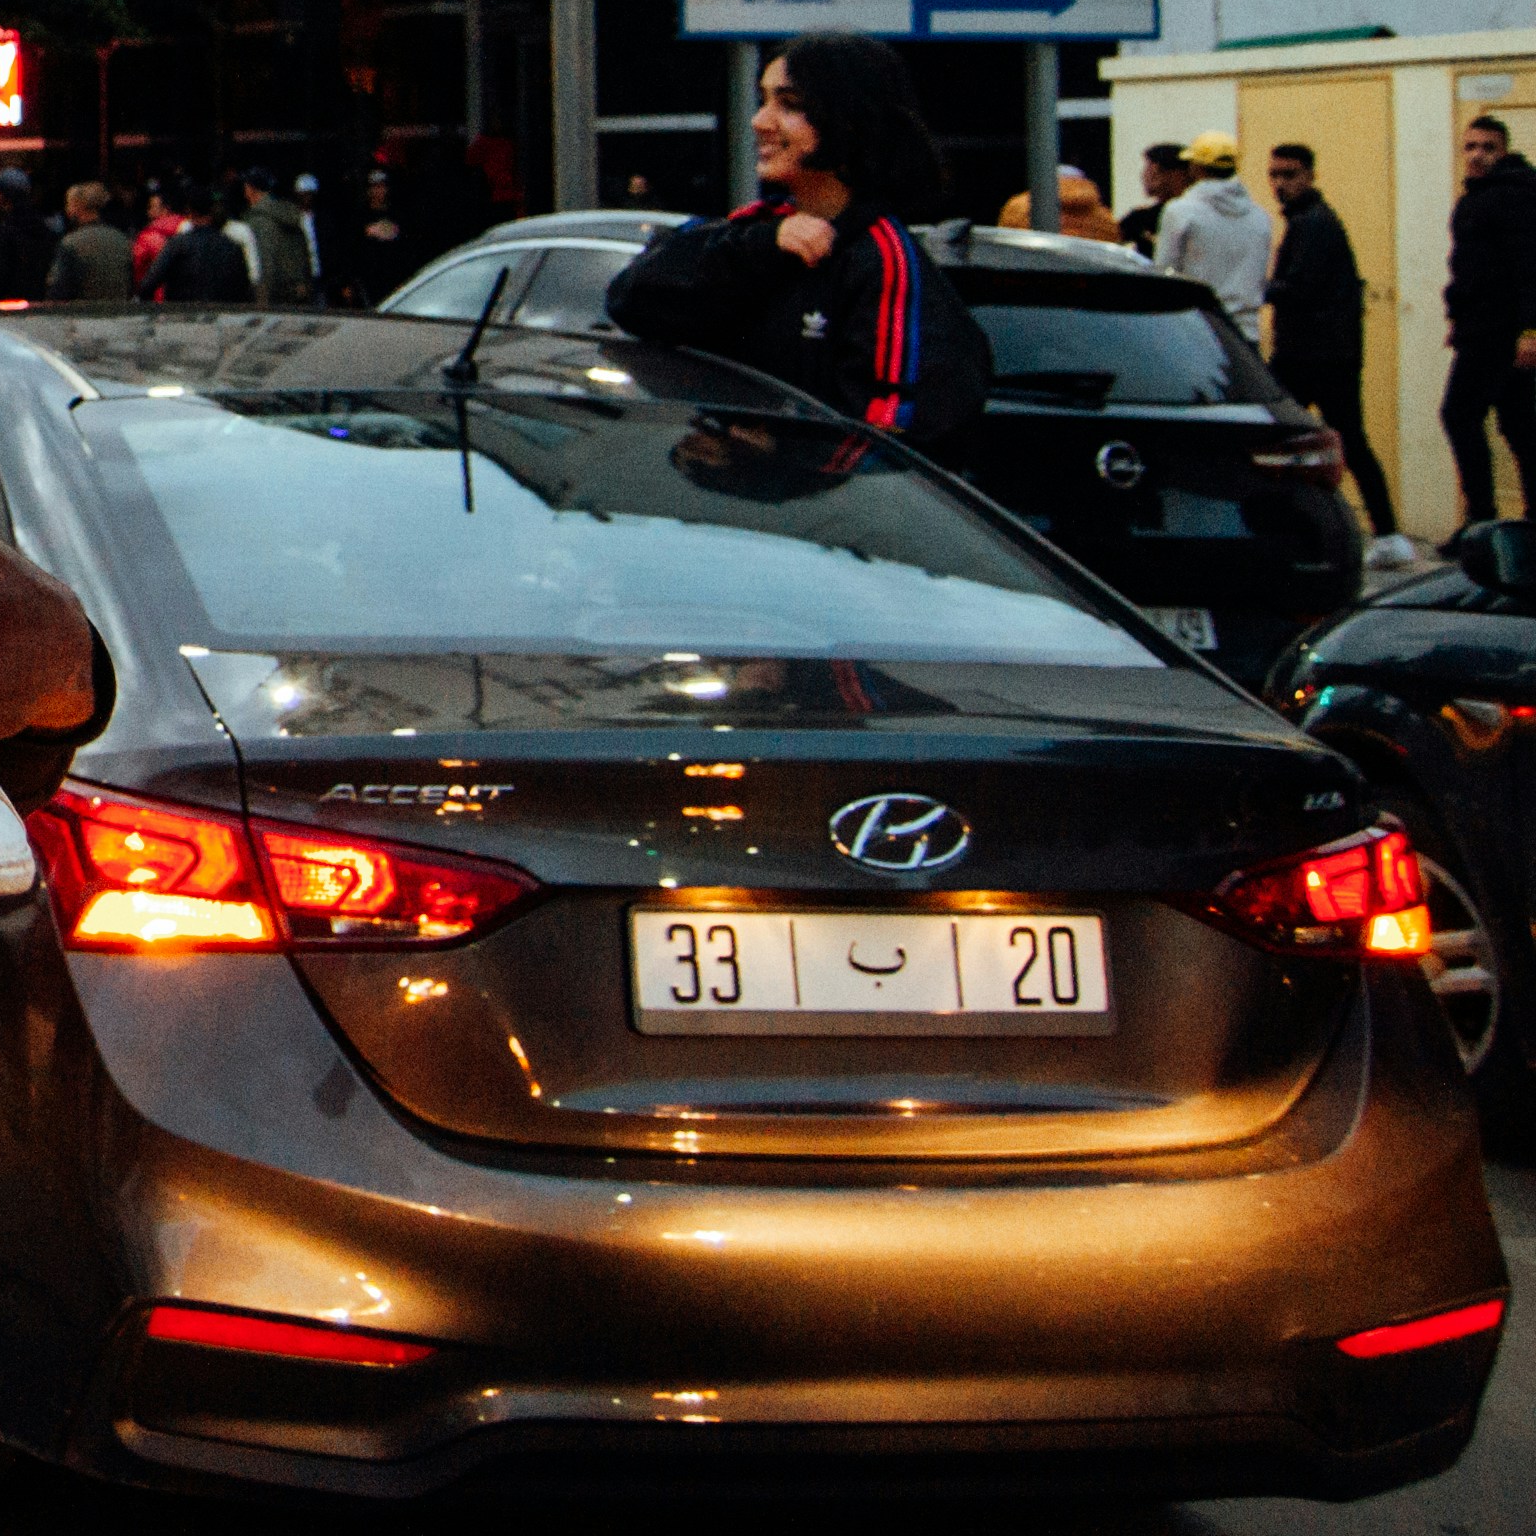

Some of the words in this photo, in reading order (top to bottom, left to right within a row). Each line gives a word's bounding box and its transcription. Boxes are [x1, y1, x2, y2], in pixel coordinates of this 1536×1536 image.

[318, 782, 516, 805] ACCENT
[666, 922, 741, 1004] 33
[847, 940, 907, 989] ب
[1008, 925, 1081, 1006] 20
